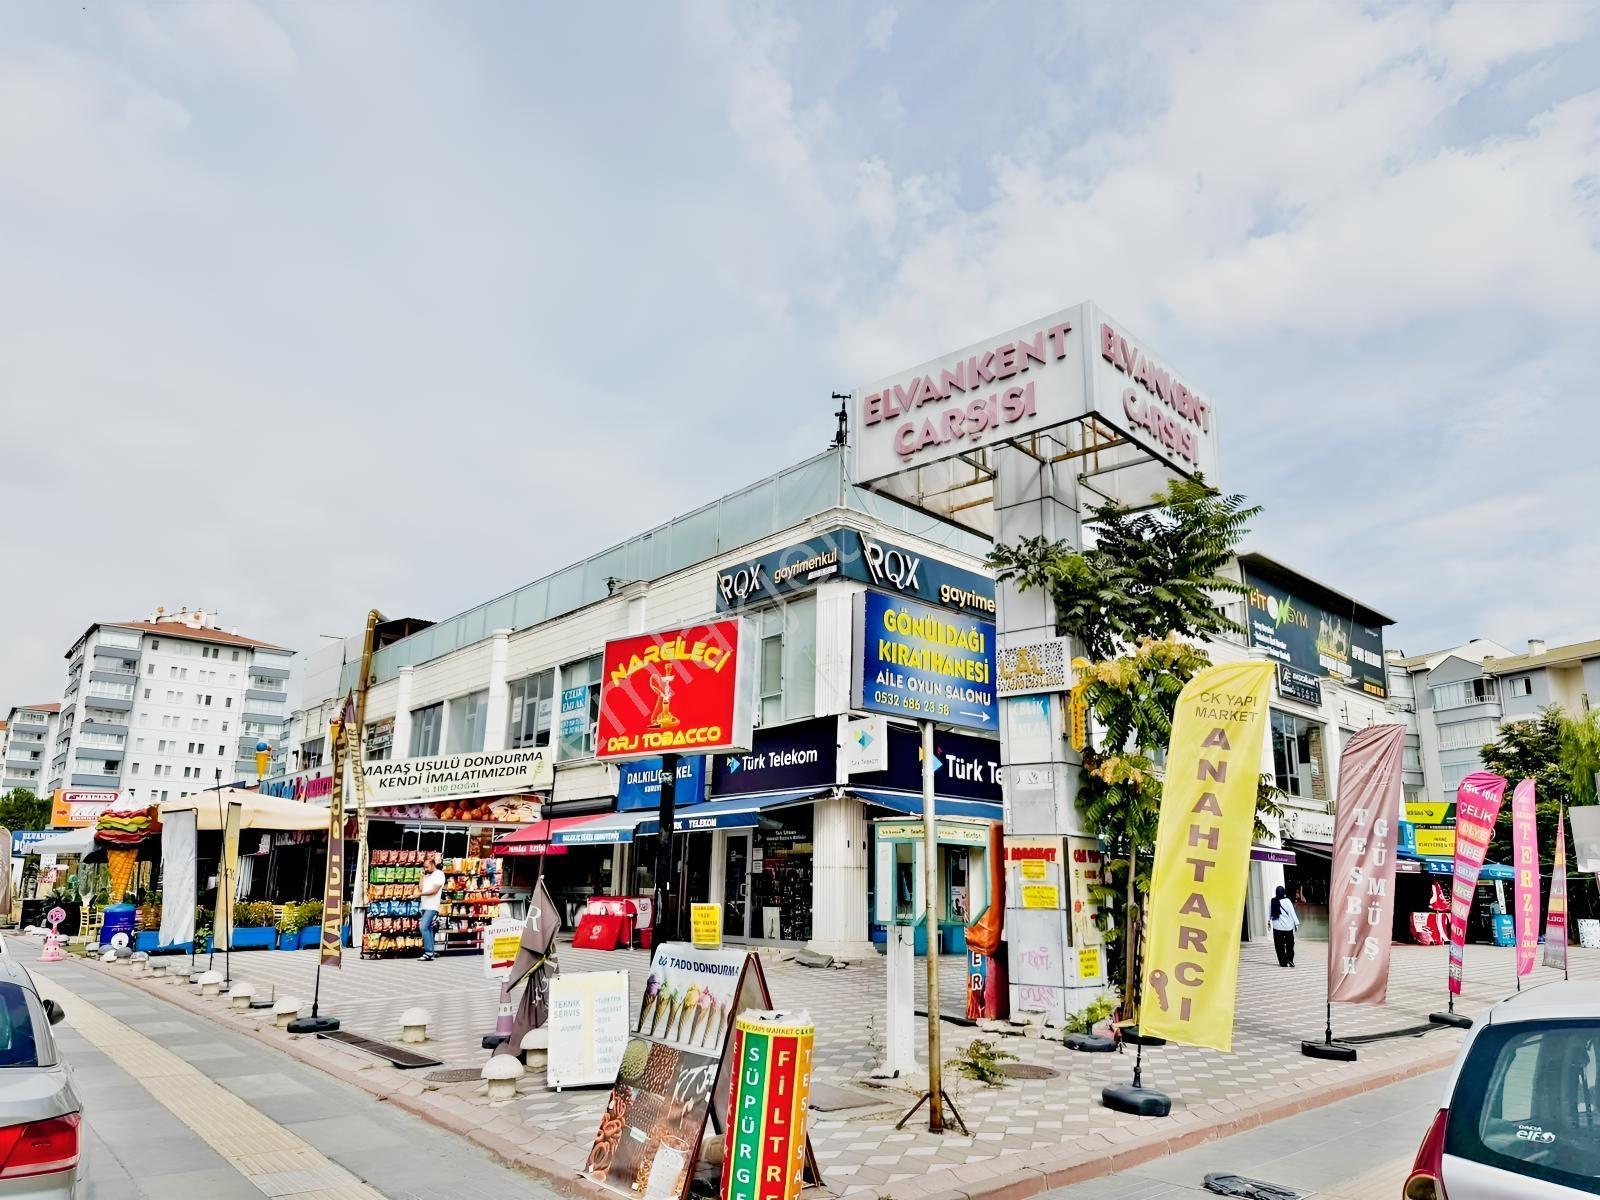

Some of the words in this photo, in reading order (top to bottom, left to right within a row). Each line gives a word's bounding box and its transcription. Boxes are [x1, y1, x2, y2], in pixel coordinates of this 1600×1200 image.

[864, 322, 1072, 426] ELVANKENT
[893, 382, 1038, 462] ÇARŞISI
[718, 563, 761, 603] RQX
[774, 547, 838, 584] gayrimenkul
[860, 533, 920, 590] RQX
[940, 584, 996, 612] gayrime
[878, 638, 990, 685] KIRATHANESİ
[876, 669, 904, 689] AİLE
[907, 677, 942, 696] OYUN
[946, 685, 991, 706] SALONU
[1226, 694, 1257, 707] YAPI
[875, 691, 900, 706] 0532
[903, 697, 921, 711] 686
[938, 702, 950, 716] 58
[1195, 706, 1259, 722] MARKET
[641, 725, 722, 748] TOBACCO
[361, 763, 411, 777] MARAŞ
[415, 757, 460, 772] USULÜ
[464, 751, 543, 768] DONDURMA
[676, 764, 693, 778] KEL
[742, 754, 766, 772] Türk
[768, 748, 818, 768] Telekom
[945, 754, 984, 782] Türk
[988, 760, 1004, 783] Te
[379, 773, 422, 788] KENDİ
[426, 765, 528, 784] İMALATIMIZDIR
[1460, 801, 1494, 823] ÇELİK
[1173, 726, 1232, 1022] ANAHTARCI
[1364, 818, 1390, 961] GÜMÜŞ
[670, 958, 692, 971] TADO
